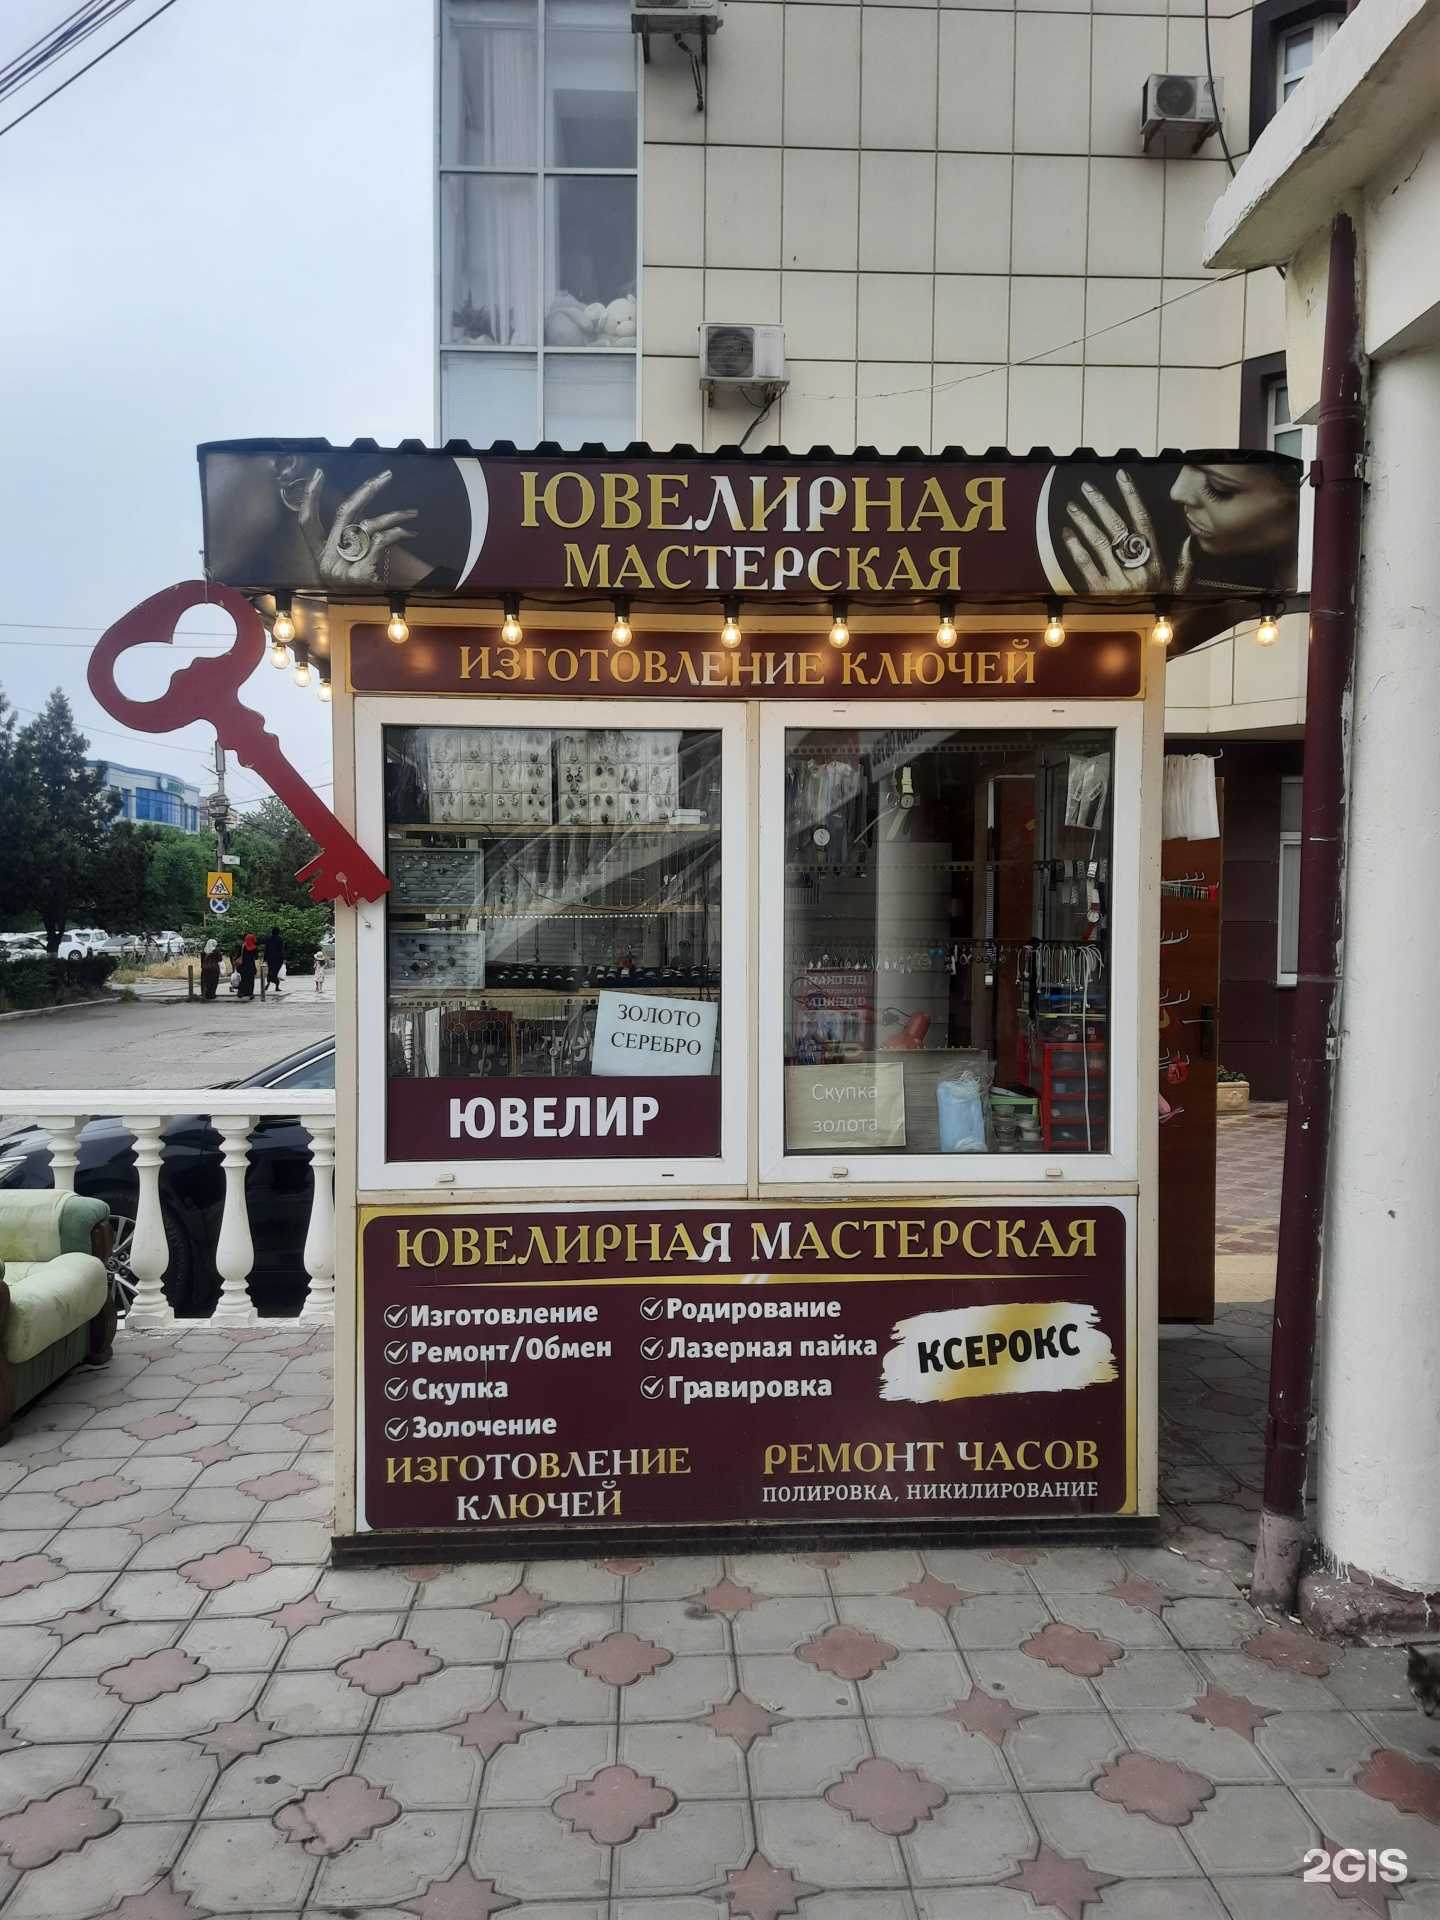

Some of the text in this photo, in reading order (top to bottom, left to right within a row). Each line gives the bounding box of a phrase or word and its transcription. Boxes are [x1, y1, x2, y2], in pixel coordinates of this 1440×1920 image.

[520, 471, 1006, 532] ЮВЕЛИРНАЯ
[564, 543, 961, 591] МАСТЕРСКАЯ
[459, 638, 1036, 687] ИЗГОТОВЛЕНИЕ КЛЮЧЕЙ
[617, 1003, 701, 1029] ЗОЛОТО
[611, 1031, 701, 1057] СЕРЕБРО
[812, 1083, 879, 1103] Скупка
[450, 1097, 659, 1139] ЮВЕЛИР
[813, 1118, 879, 1133] золота
[396, 1219, 1097, 1268] ЮВЕЛИРНАЯ МАСТЕРСКАЯ
[411, 1304, 599, 1328] Изготовление
[667, 1298, 842, 1324] Родирование
[411, 1335, 612, 1363] Ремонт/Обмен
[667, 1334, 878, 1363] Лазерная пайка
[917, 1323, 1081, 1374] КСЕРОКС
[412, 1377, 509, 1405] Скупка
[669, 1376, 833, 1405] Гравировка
[412, 1415, 558, 1439] Золочение
[385, 1447, 692, 1484] ИЗГОТОВЛЕНИЕ
[763, 1440, 1099, 1475] РЕМОНТ ЧАСОВ
[456, 1480, 623, 1521] КЛЮЧЕЙ
[762, 1481, 1099, 1502] ПОЛИРОВКА, НИКИЛИРОВАНИЕ
